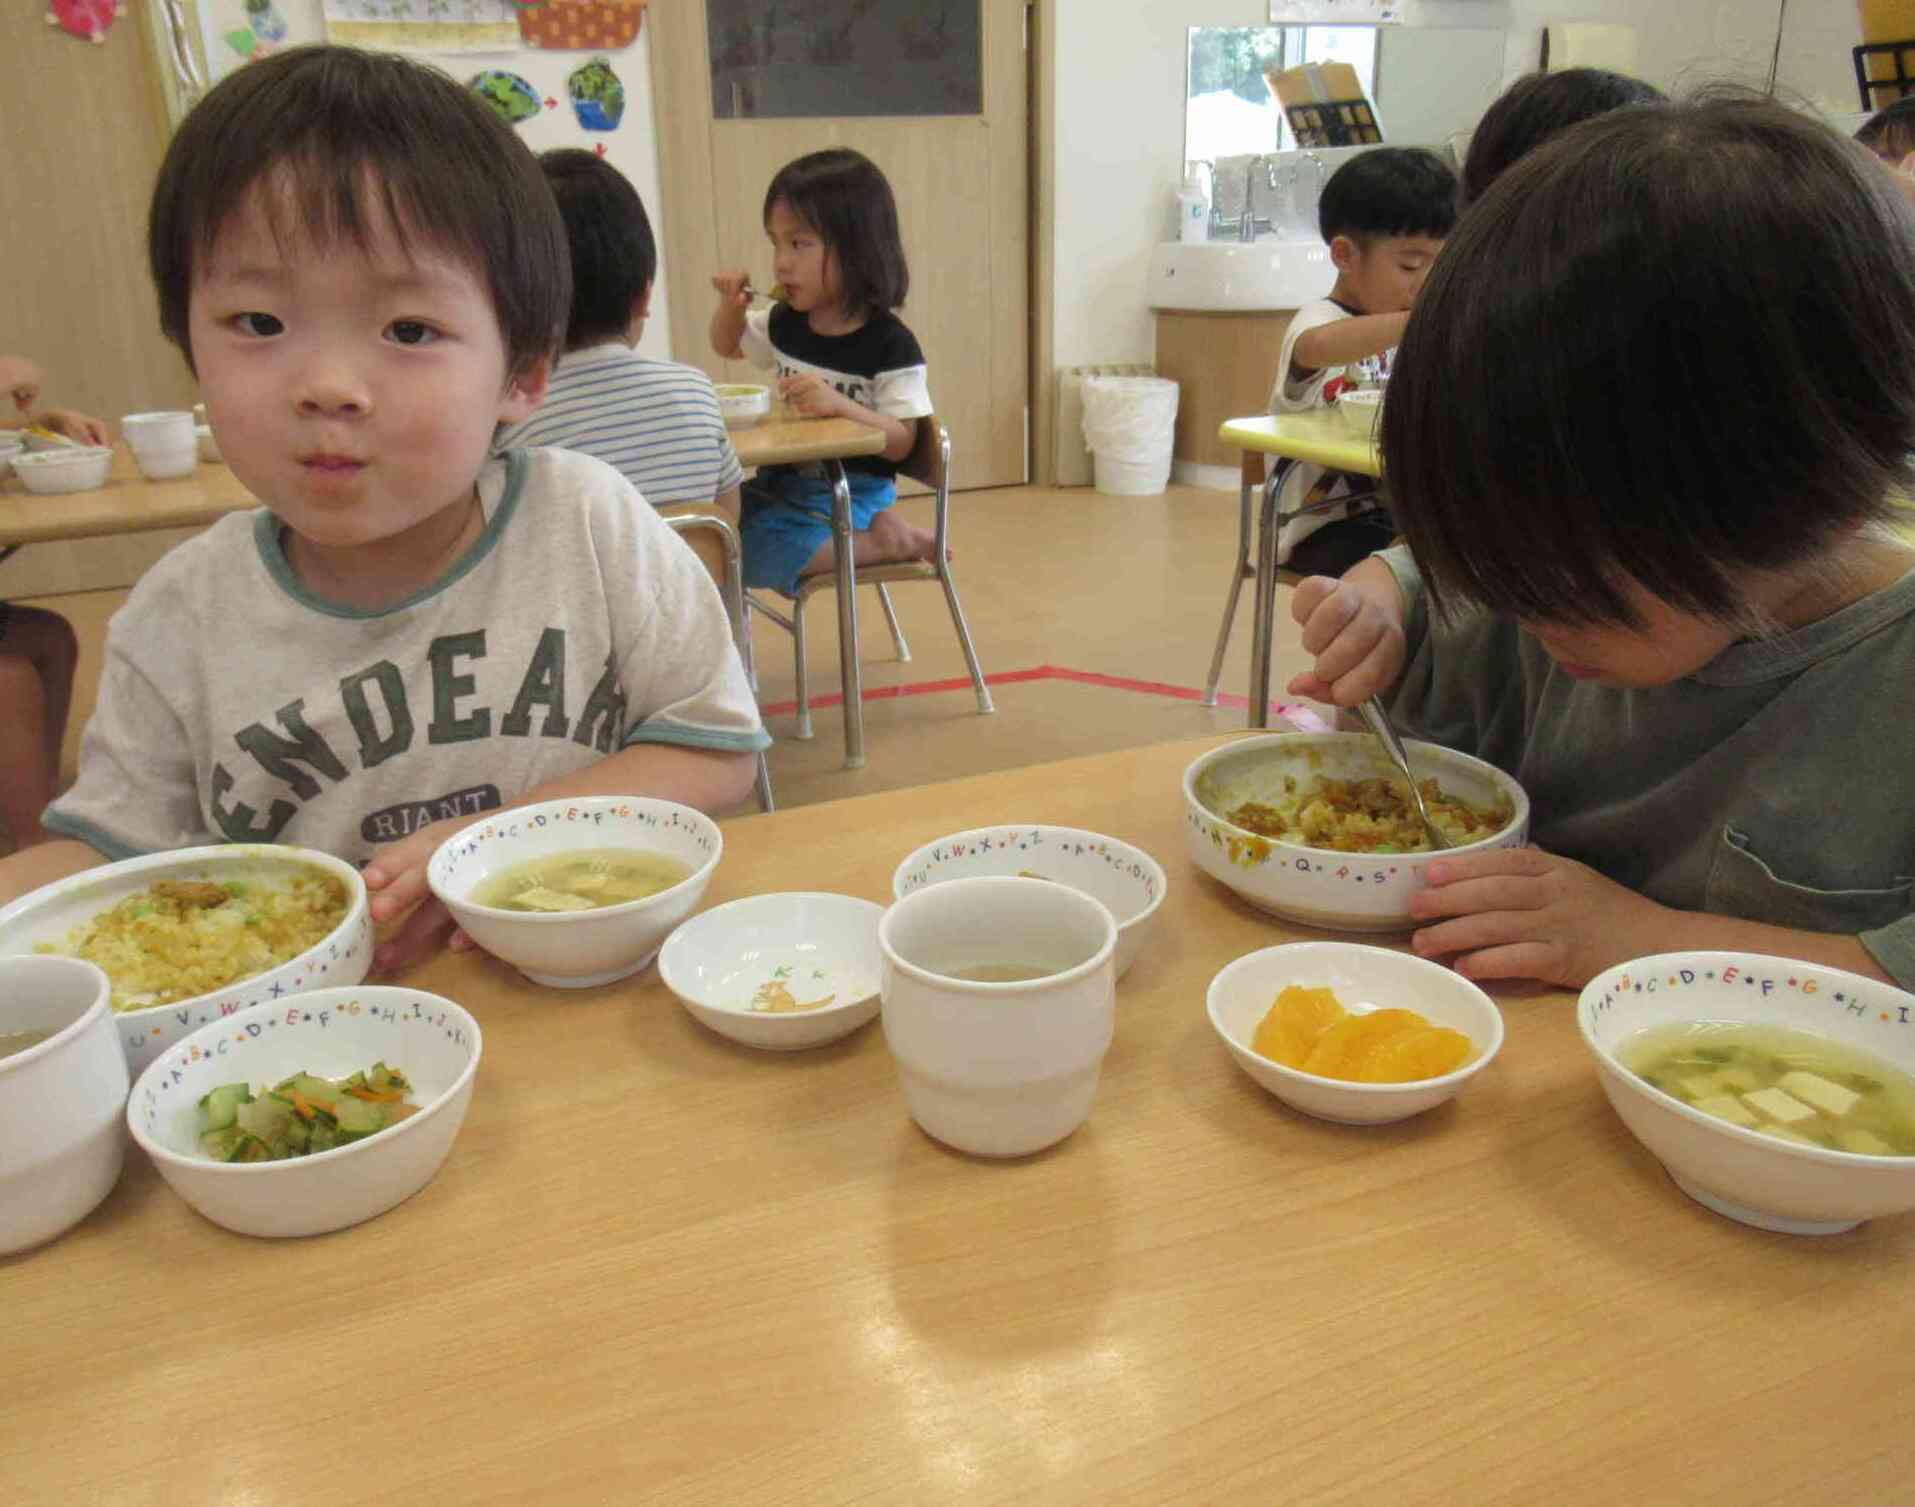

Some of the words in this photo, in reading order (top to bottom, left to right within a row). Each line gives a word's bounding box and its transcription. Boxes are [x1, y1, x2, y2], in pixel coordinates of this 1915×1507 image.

[535, 814, 546, 827] D
[567, 807, 578, 821] E
[594, 812, 604, 825] F
[952, 842, 967, 858] W
[980, 838, 992, 854] X
[1295, 858, 1311, 873] Q
[1335, 866, 1350, 881] R
[1374, 871, 1386, 884] S
[177, 1010, 188, 1026] V
[220, 1001, 241, 1017] W
[269, 980, 285, 999] X
[1647, 977, 1657, 993] C
[1679, 969, 1696, 985] D
[1722, 966, 1740, 984] E
[1761, 979, 1775, 997] F
[1802, 978, 1818, 994] G
[1847, 998, 1868, 1017] H
[1897, 1006, 1910, 1024] I
[217, 1039, 229, 1055] C
[246, 1022, 262, 1038] D
[286, 1009, 300, 1025] E
